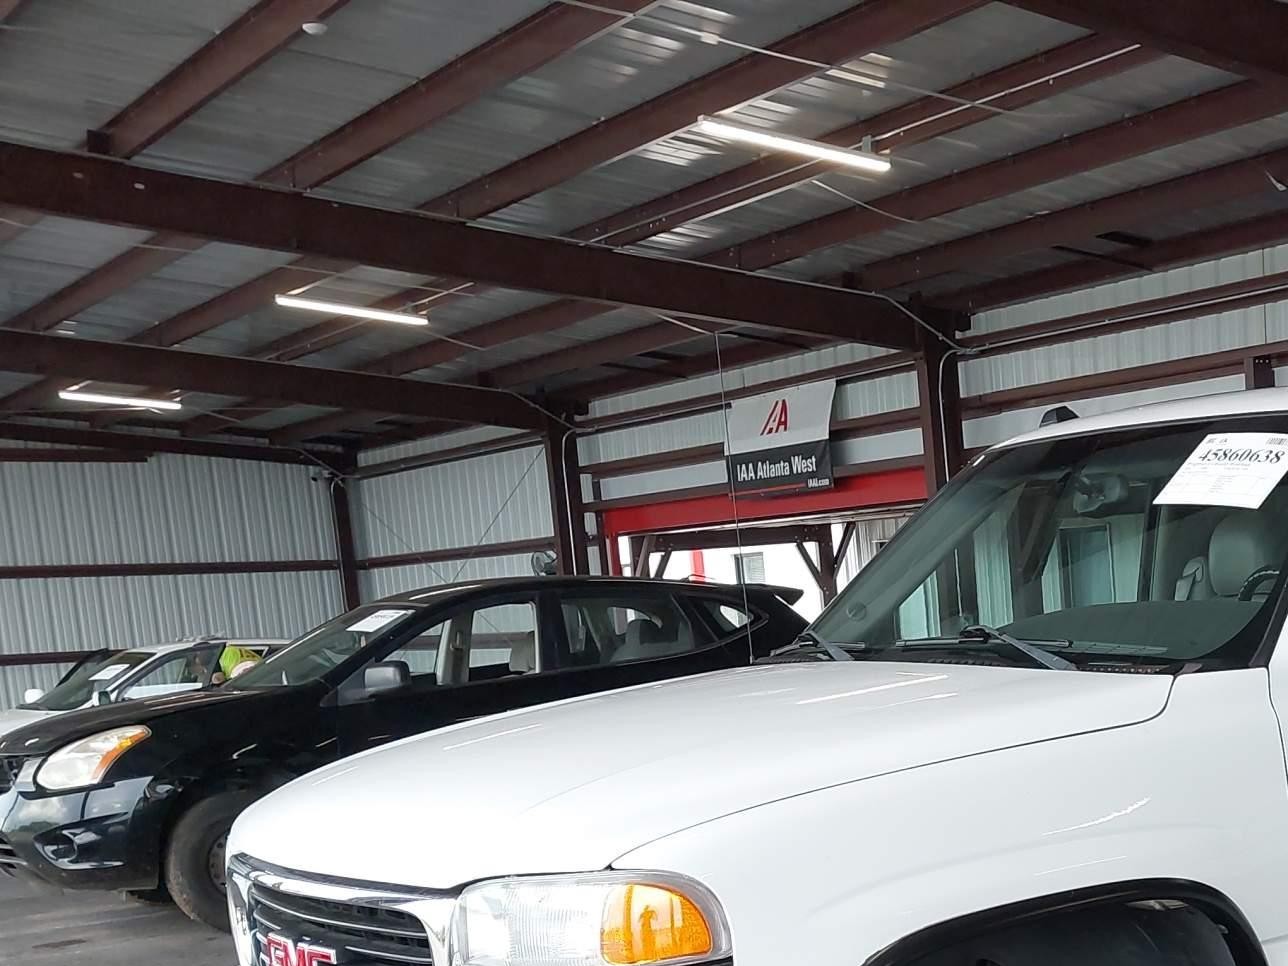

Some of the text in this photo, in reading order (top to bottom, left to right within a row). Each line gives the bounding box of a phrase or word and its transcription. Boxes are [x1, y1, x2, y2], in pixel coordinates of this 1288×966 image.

[1198, 448, 1285, 464] 45860638
[737, 454, 816, 481] IAA Atlanta West
